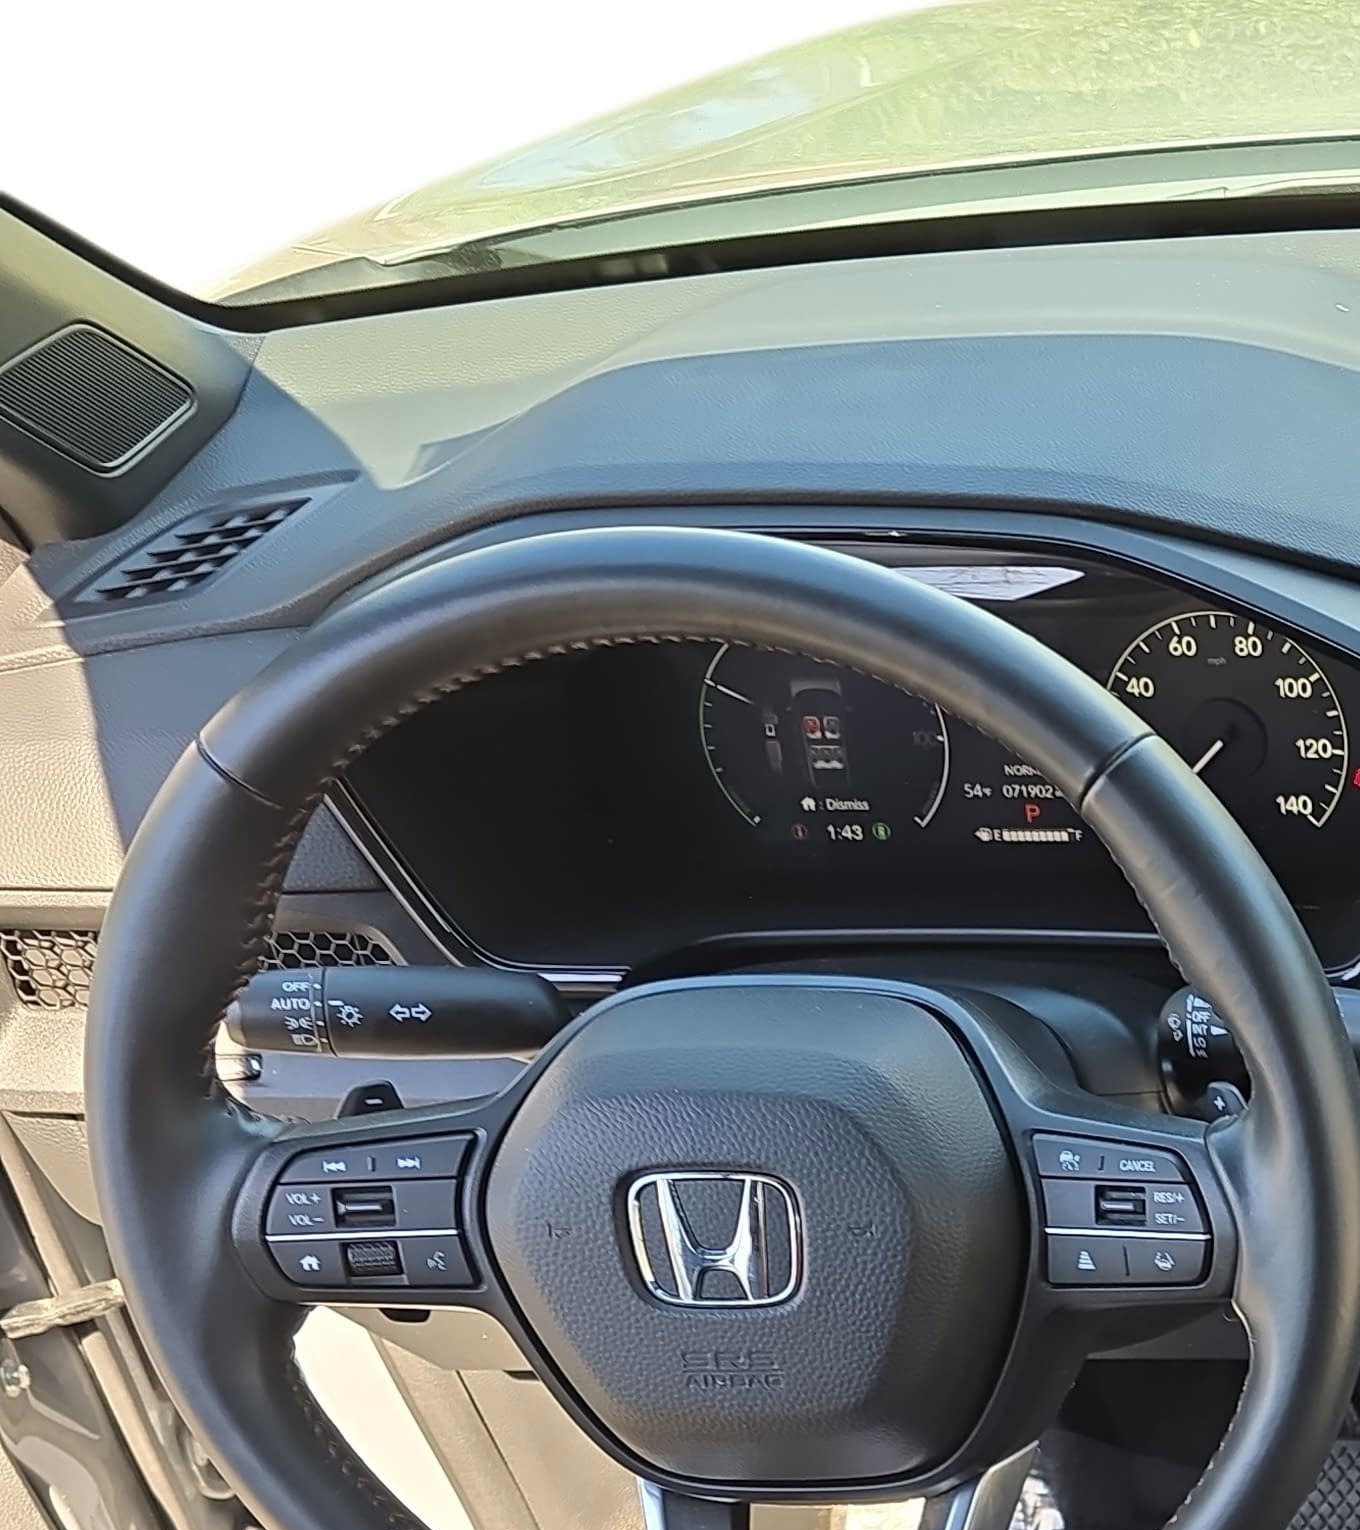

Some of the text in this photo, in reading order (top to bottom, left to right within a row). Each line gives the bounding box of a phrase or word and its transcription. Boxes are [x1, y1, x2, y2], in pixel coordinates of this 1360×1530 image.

[1168, 636, 1197, 657] 60
[1234, 636, 1262, 657] 80
[1126, 677, 1155, 698] 40
[1275, 678, 1312, 698] 100
[1296, 739, 1332, 758] 120
[825, 798, 870, 811] Dismiss
[1025, 804, 1041, 823] P
[1276, 796, 1312, 816] 140
[826, 824, 863, 840] 1:43
[282, 981, 310, 992] OFF
[271, 998, 311, 1010] AUTO
[1119, 1159, 1156, 1173] CANCEL
